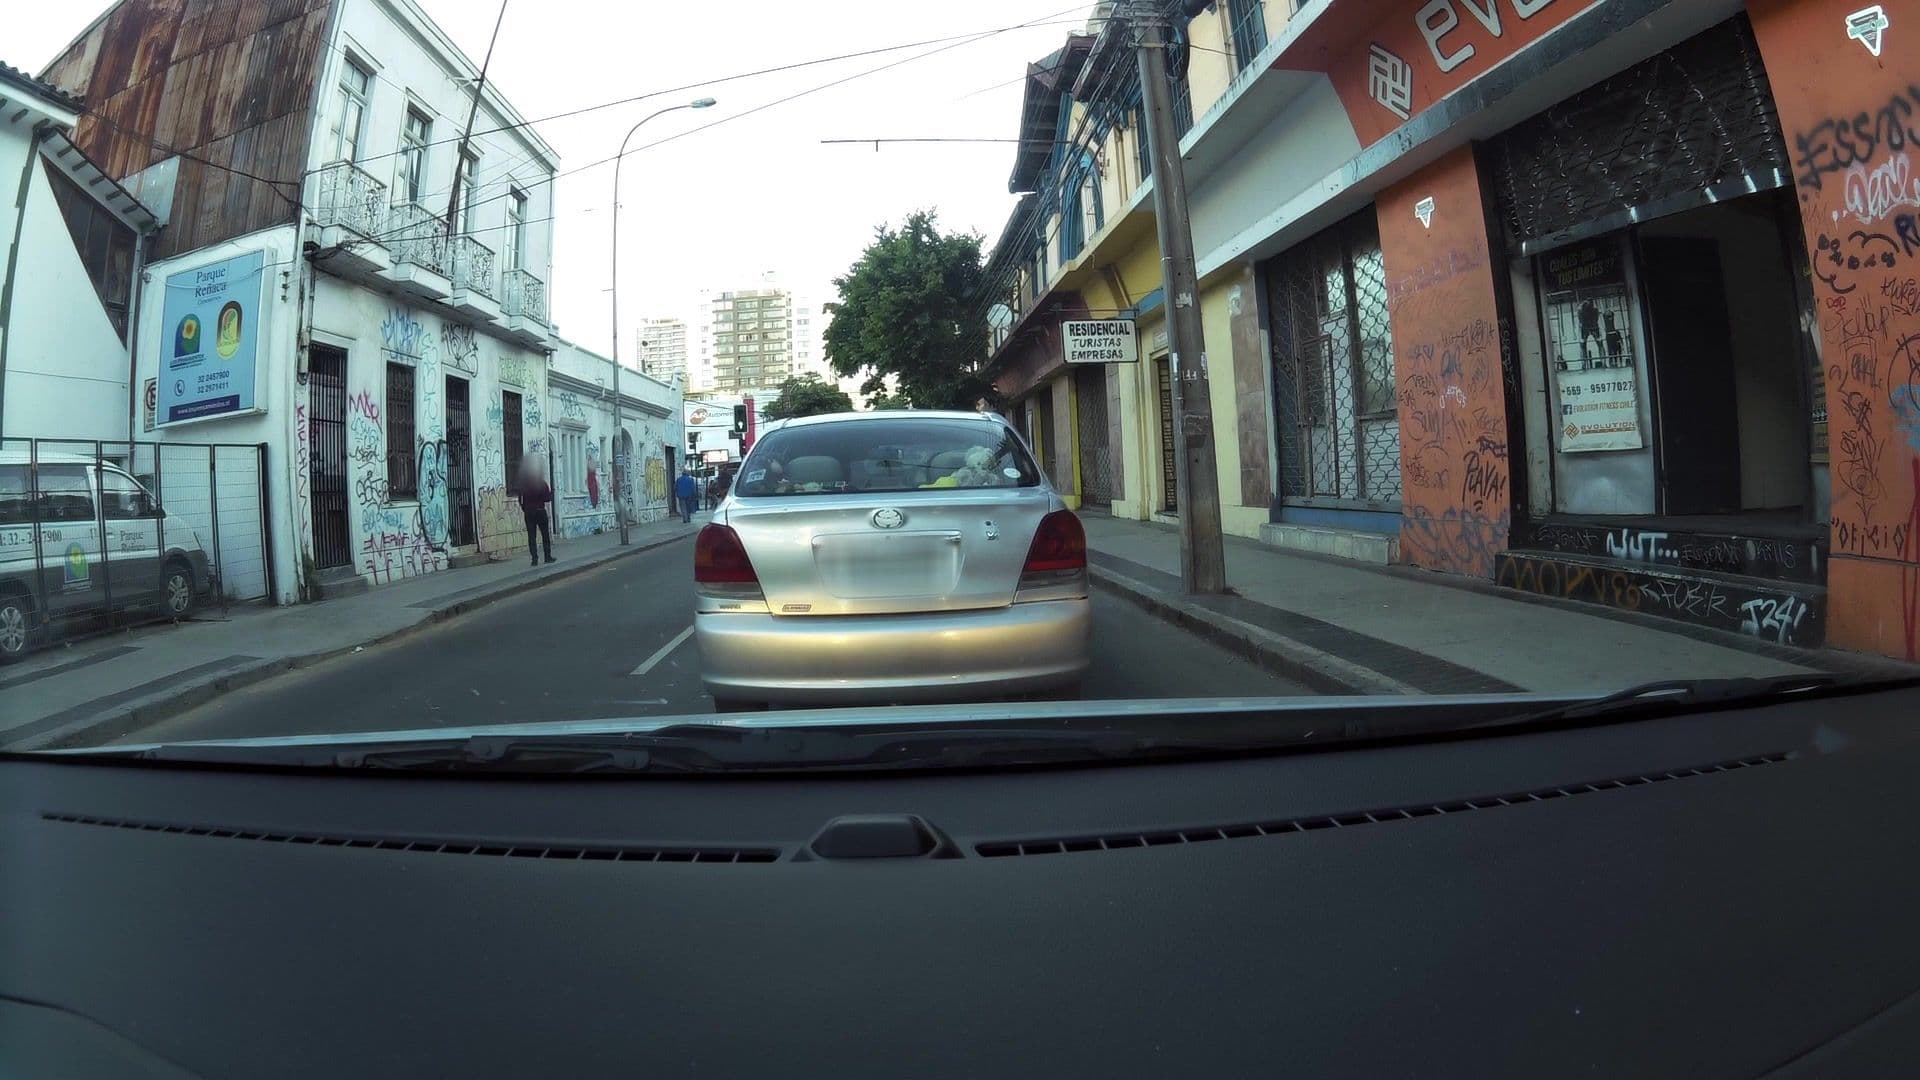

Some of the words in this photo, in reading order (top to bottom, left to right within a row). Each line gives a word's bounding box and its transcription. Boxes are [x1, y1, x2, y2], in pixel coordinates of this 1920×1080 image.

[196, 268, 226, 283] Parque
[195, 281, 227, 298] Reñaca
[1069, 322, 1130, 337] RESIDENCIAL
[1072, 338, 1122, 348] TURISTAS
[1071, 349, 1124, 360] EMPRESAS
[1590, 381, 1634, 394] 95977027
[120, 529, 144, 542] Parque
